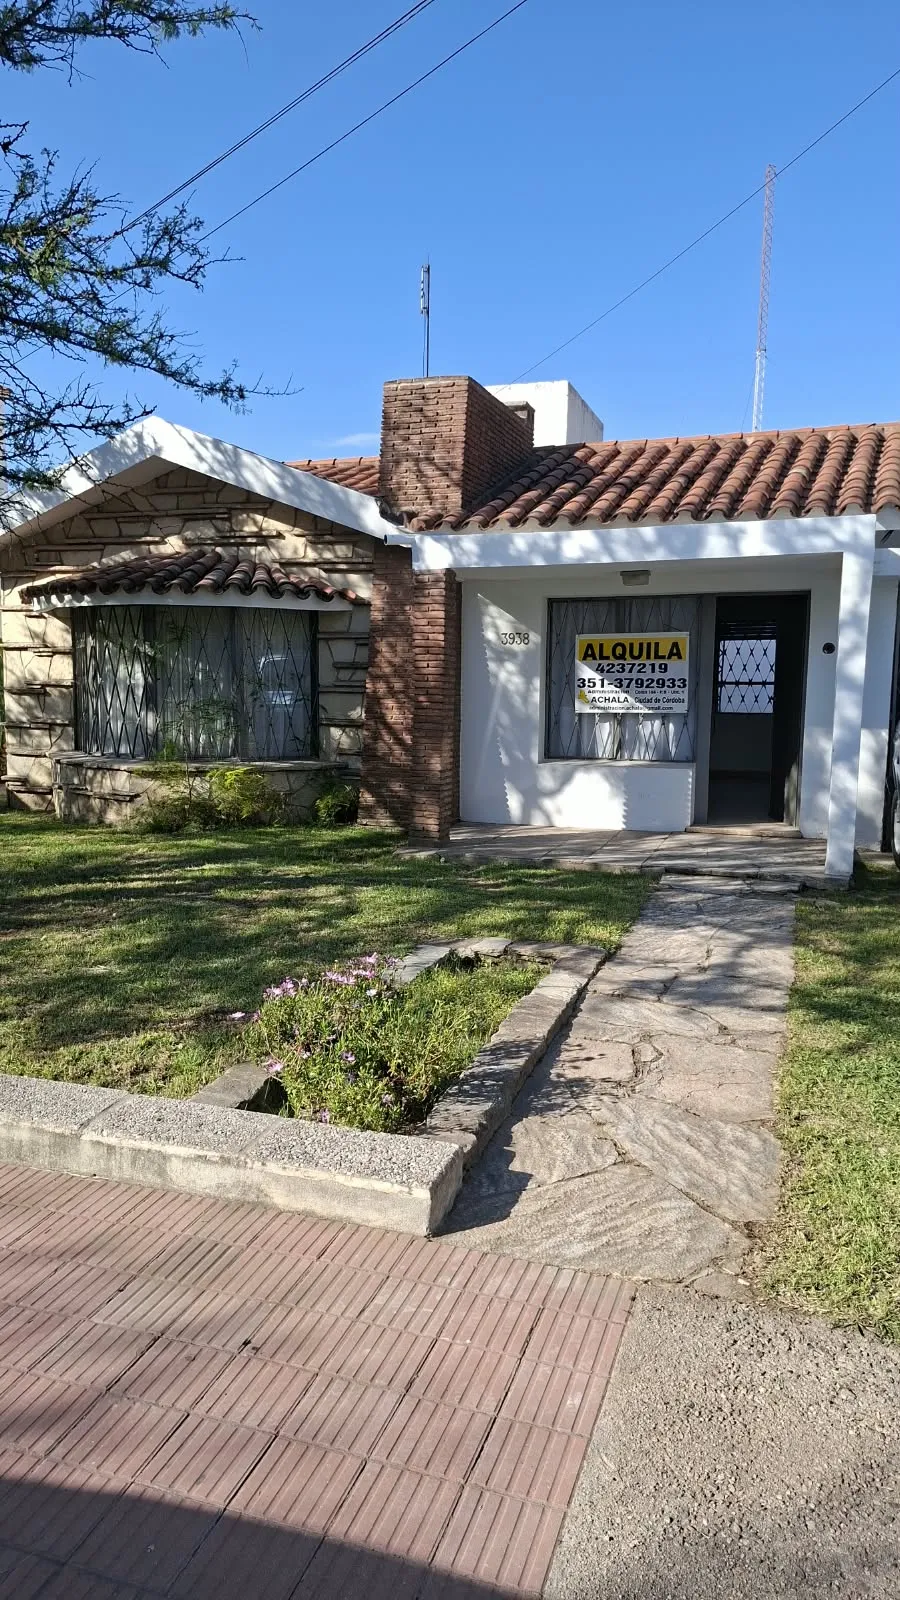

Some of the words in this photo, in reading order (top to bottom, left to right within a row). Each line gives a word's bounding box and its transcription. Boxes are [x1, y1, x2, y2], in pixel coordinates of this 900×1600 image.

[501, 632, 530, 645] 3938
[581, 641, 683, 661] ALQUILA
[595, 662, 669, 674] 4237219
[576, 677, 687, 689] 351-3792933
[591, 696, 630, 704] ACHALA
[634, 696, 653, 704] Ciudad
[654, 696, 661, 704] de
